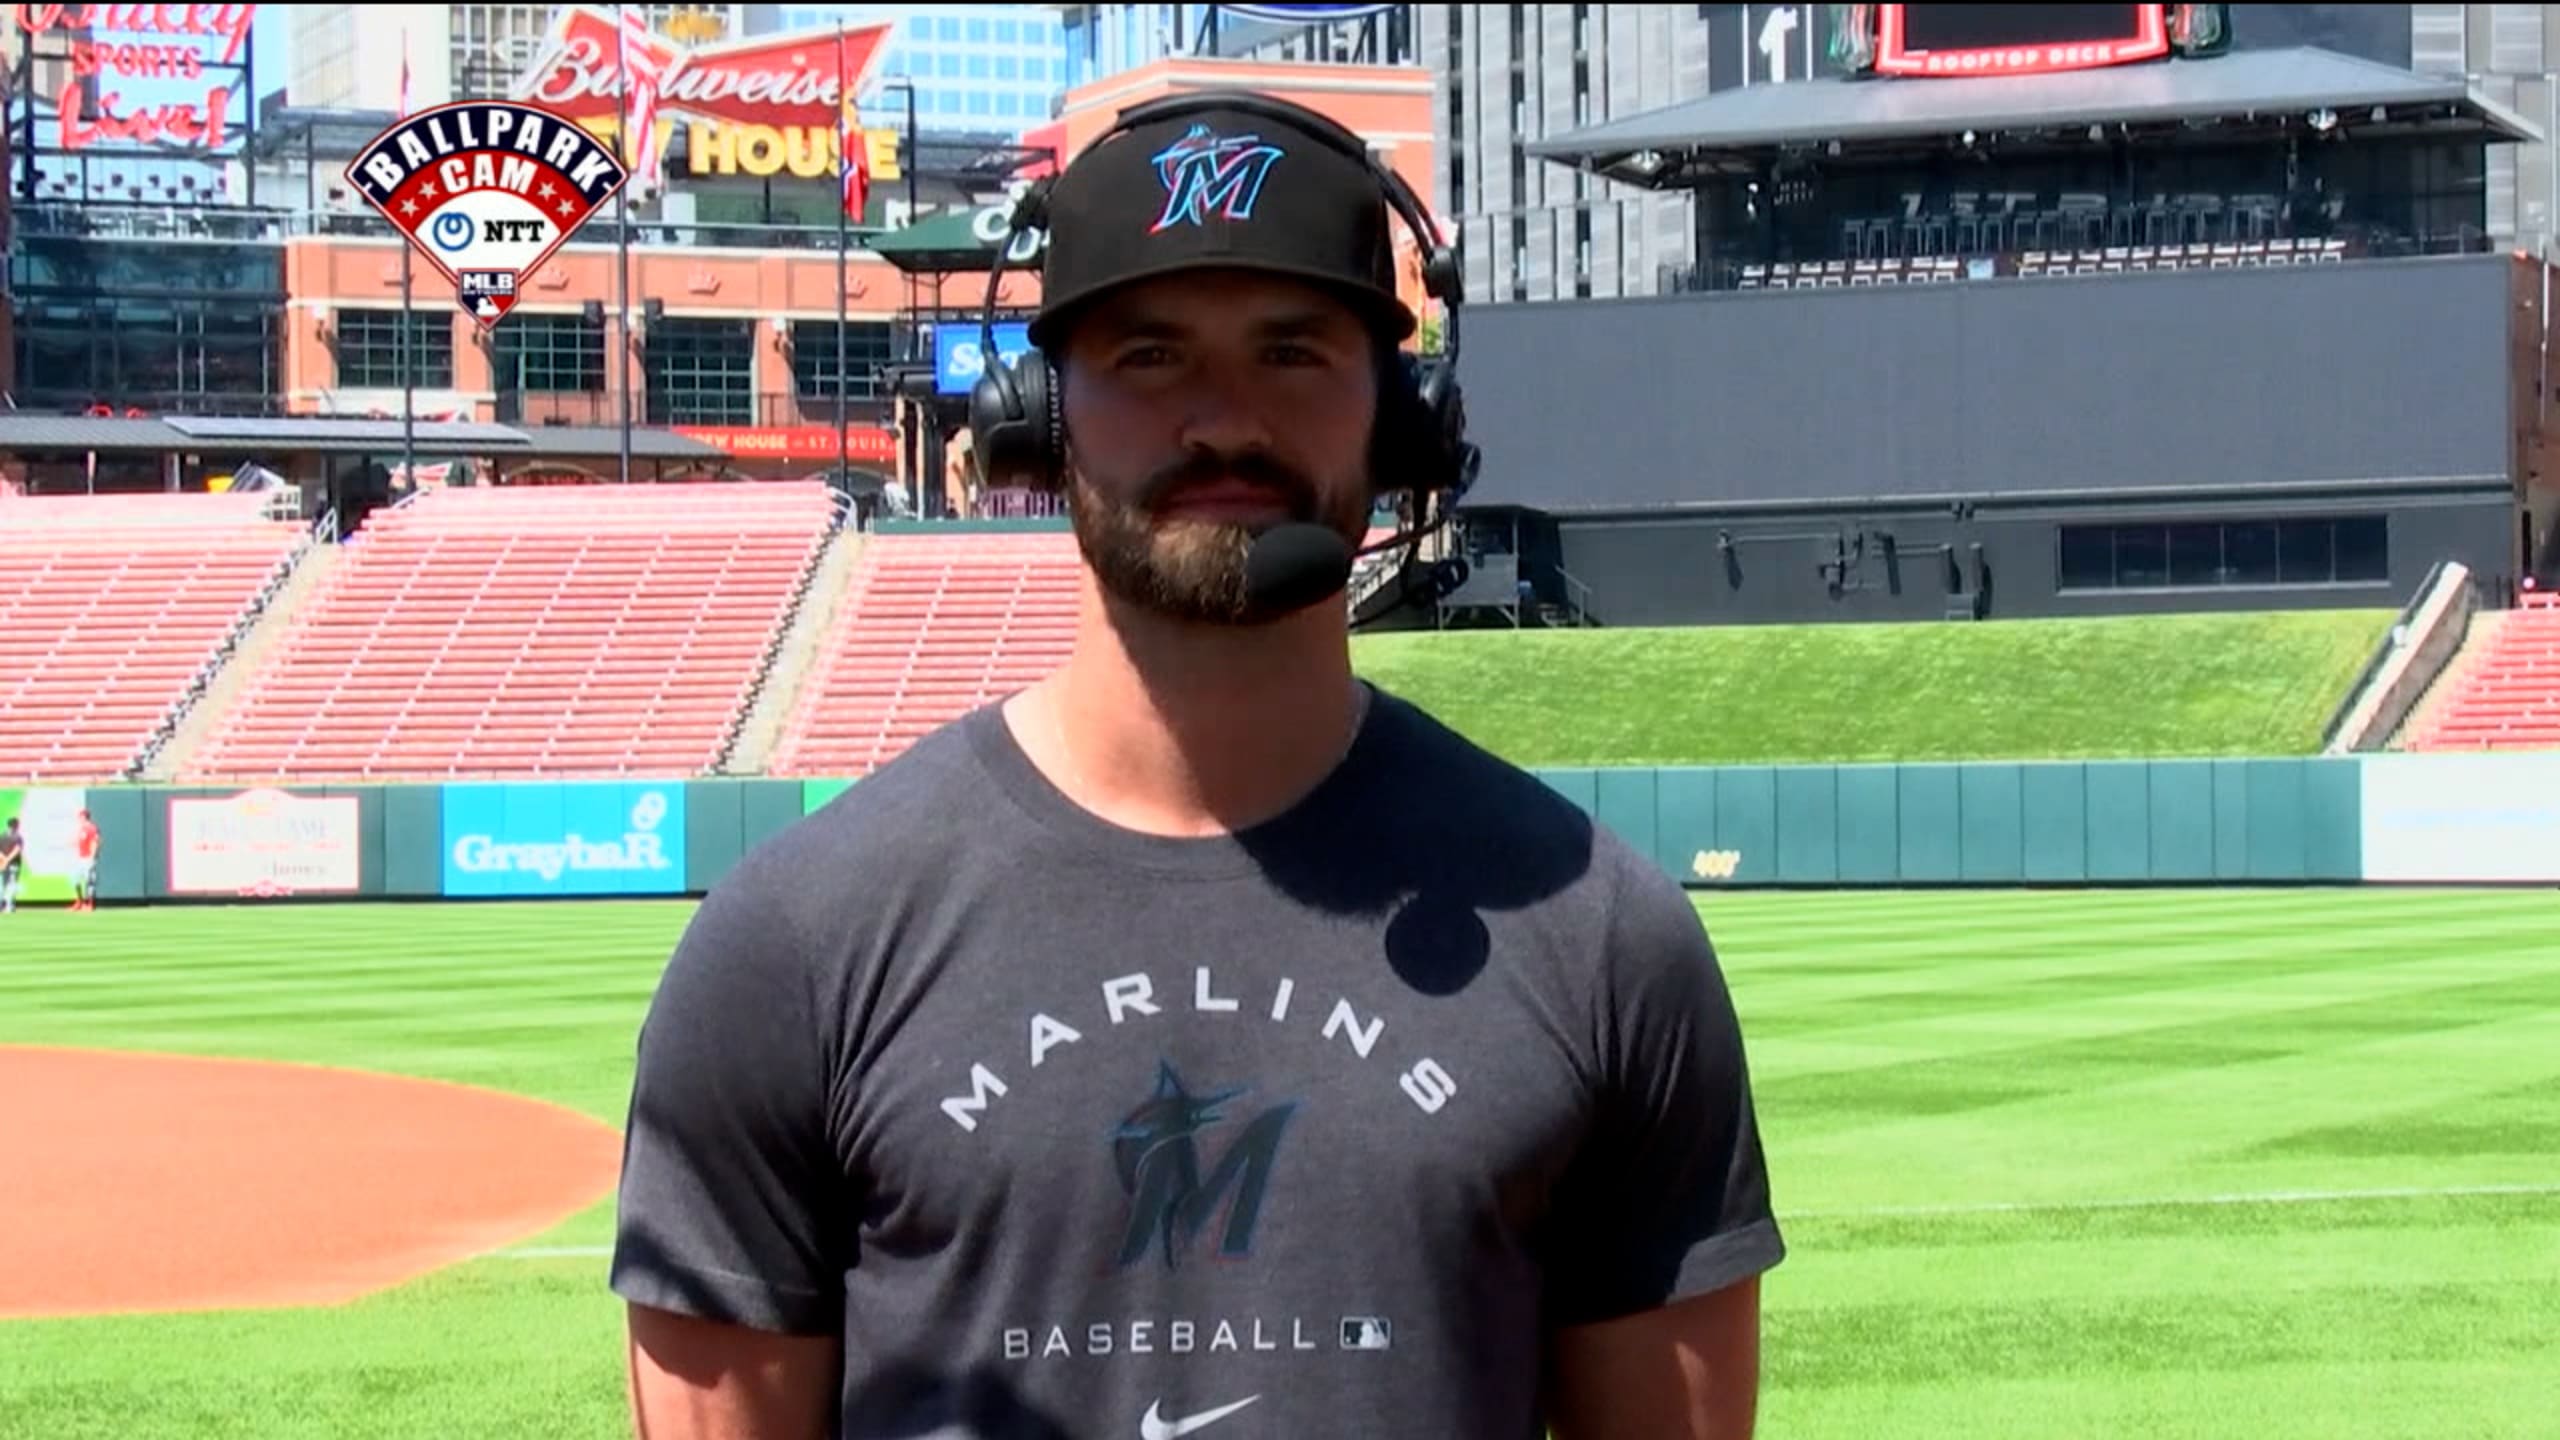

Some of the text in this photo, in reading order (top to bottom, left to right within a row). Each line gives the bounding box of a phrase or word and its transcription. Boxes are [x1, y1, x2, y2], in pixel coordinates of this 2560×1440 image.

[72, 41, 201, 78] SPORTS
[1927, 45, 2112, 72] ROOFTOP DECK
[733, 433, 788, 449] HOUSE
[940, 967, 1457, 1132] MARLINS
[1003, 1317, 1316, 1360] BASEBALL
